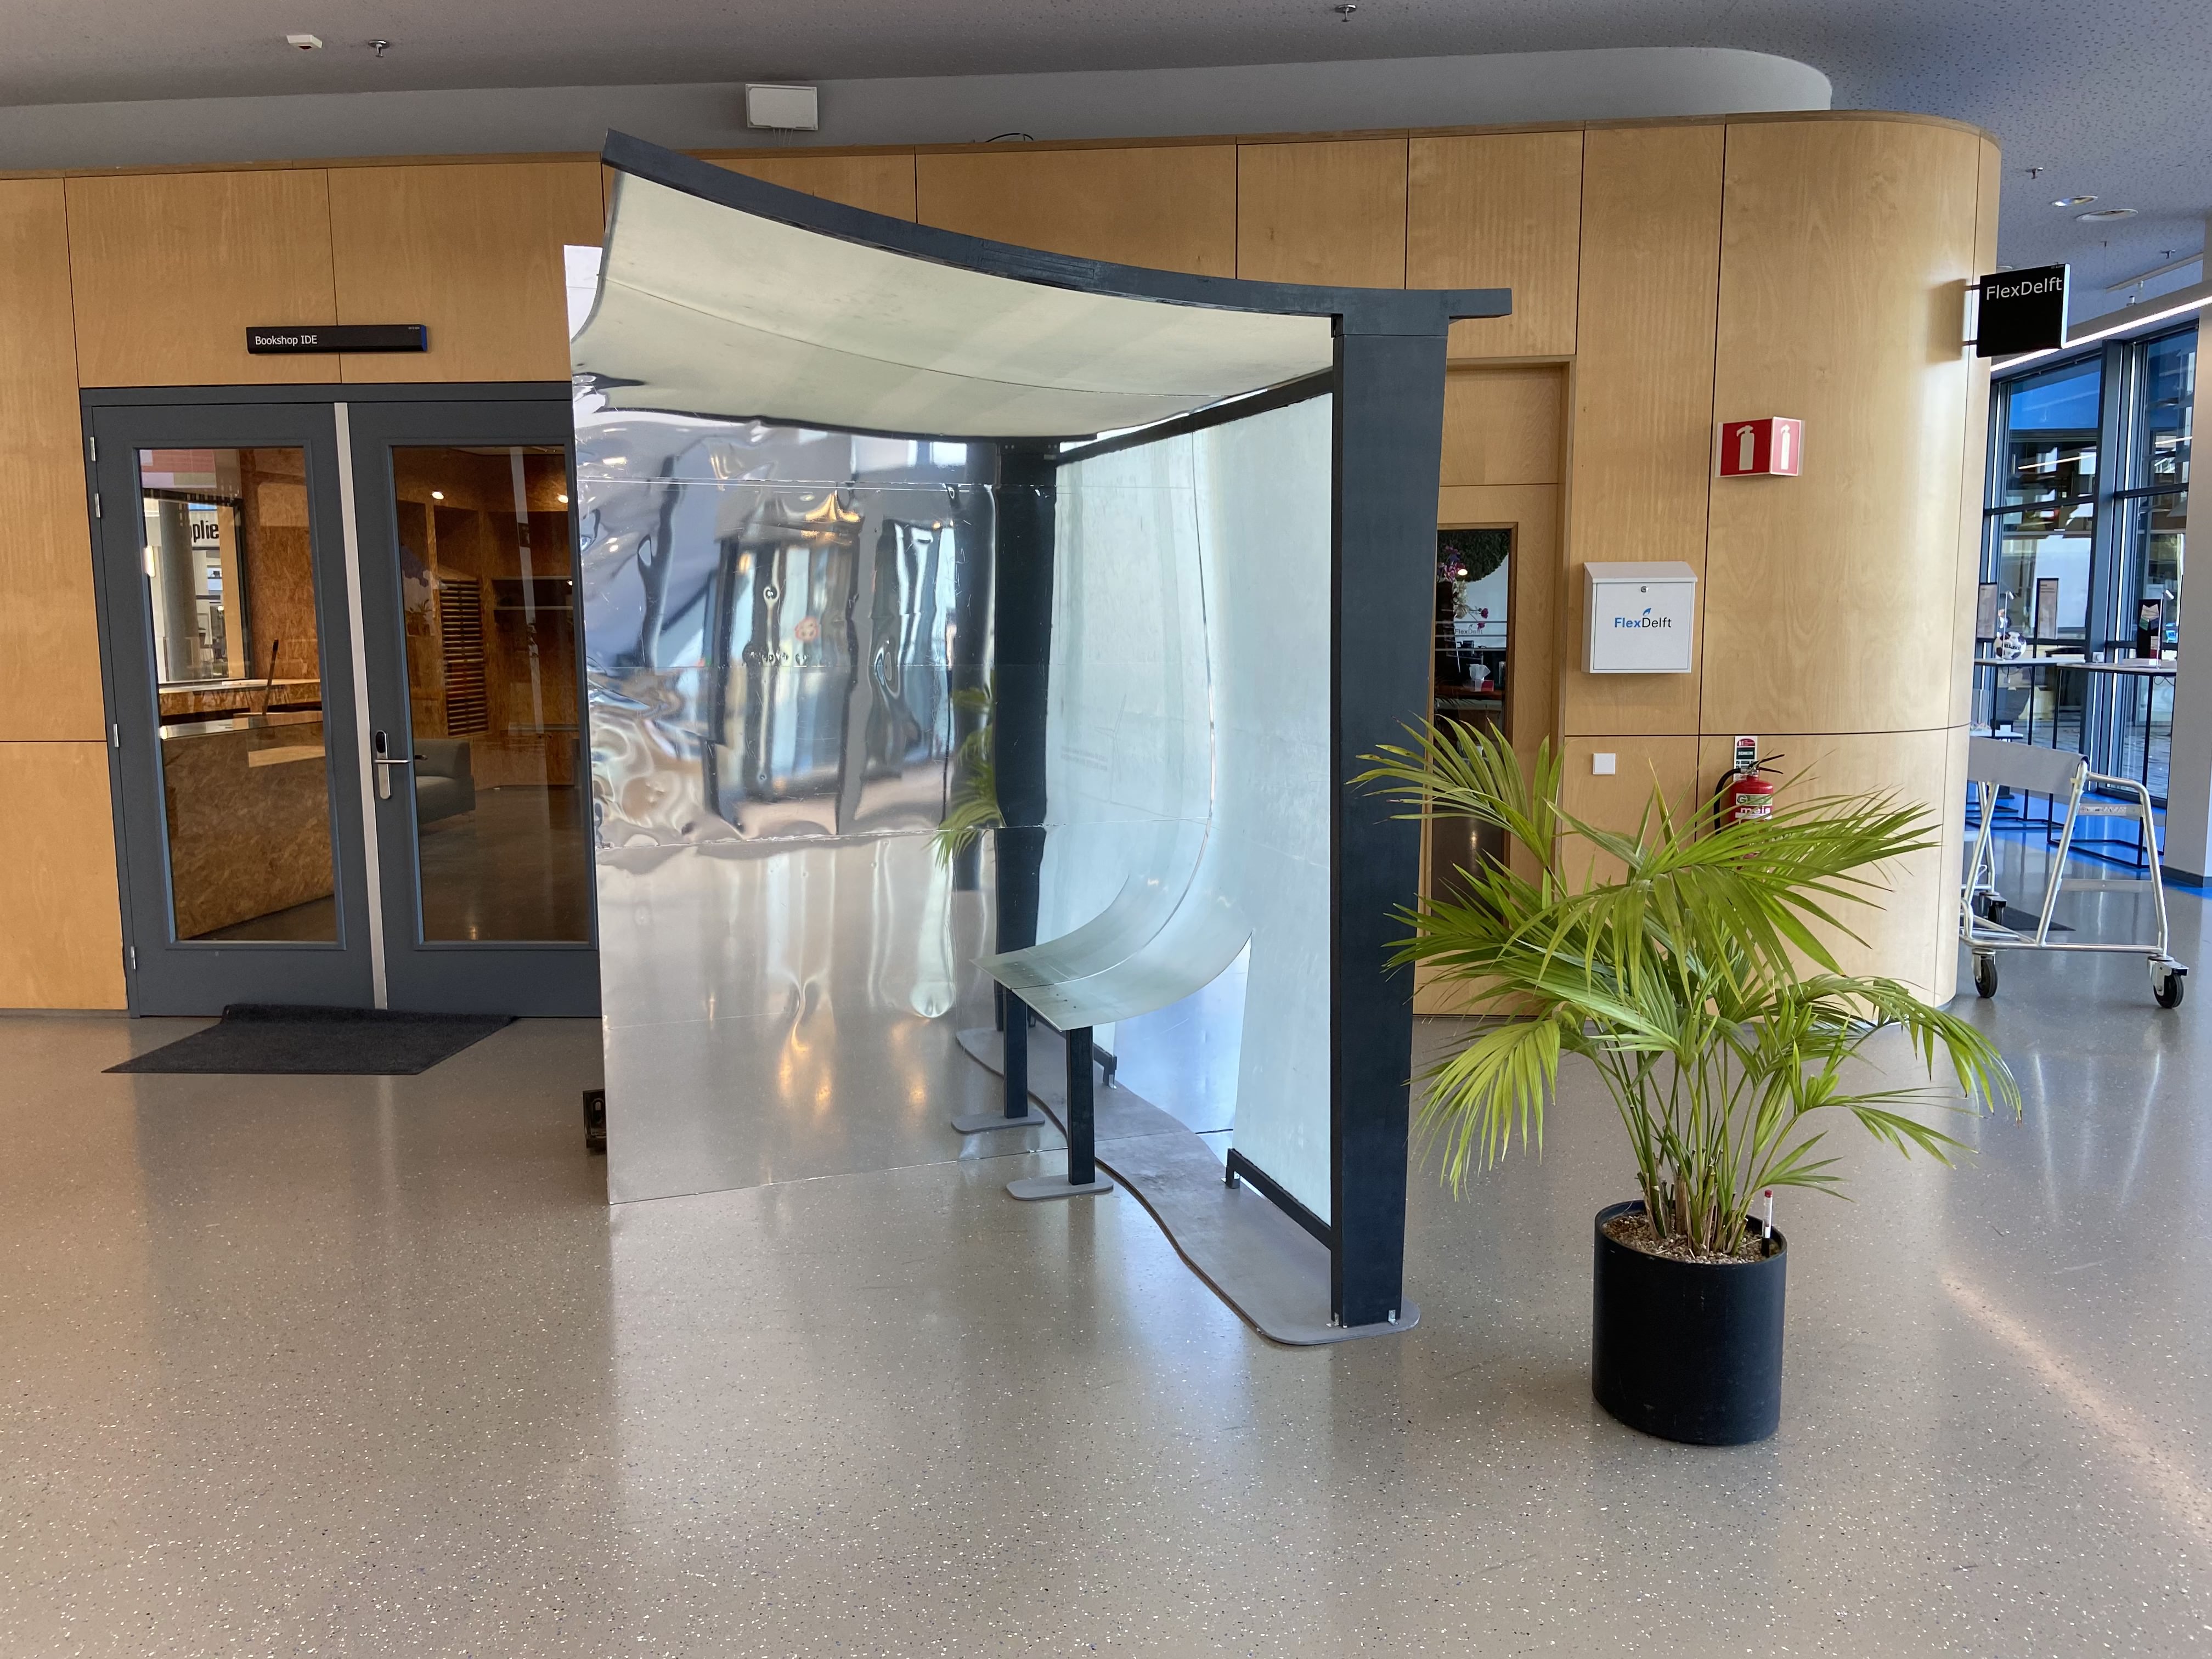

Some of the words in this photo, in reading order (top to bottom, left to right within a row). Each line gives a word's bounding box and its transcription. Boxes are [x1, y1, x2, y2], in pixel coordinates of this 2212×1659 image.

[1986, 276, 2063, 301] FlexDelft
[255, 335, 298, 347] Bookshop
[301, 335, 318, 345] IDE
[190, 520, 219, 543] plie
[1614, 617, 1672, 628] FlexDelft
